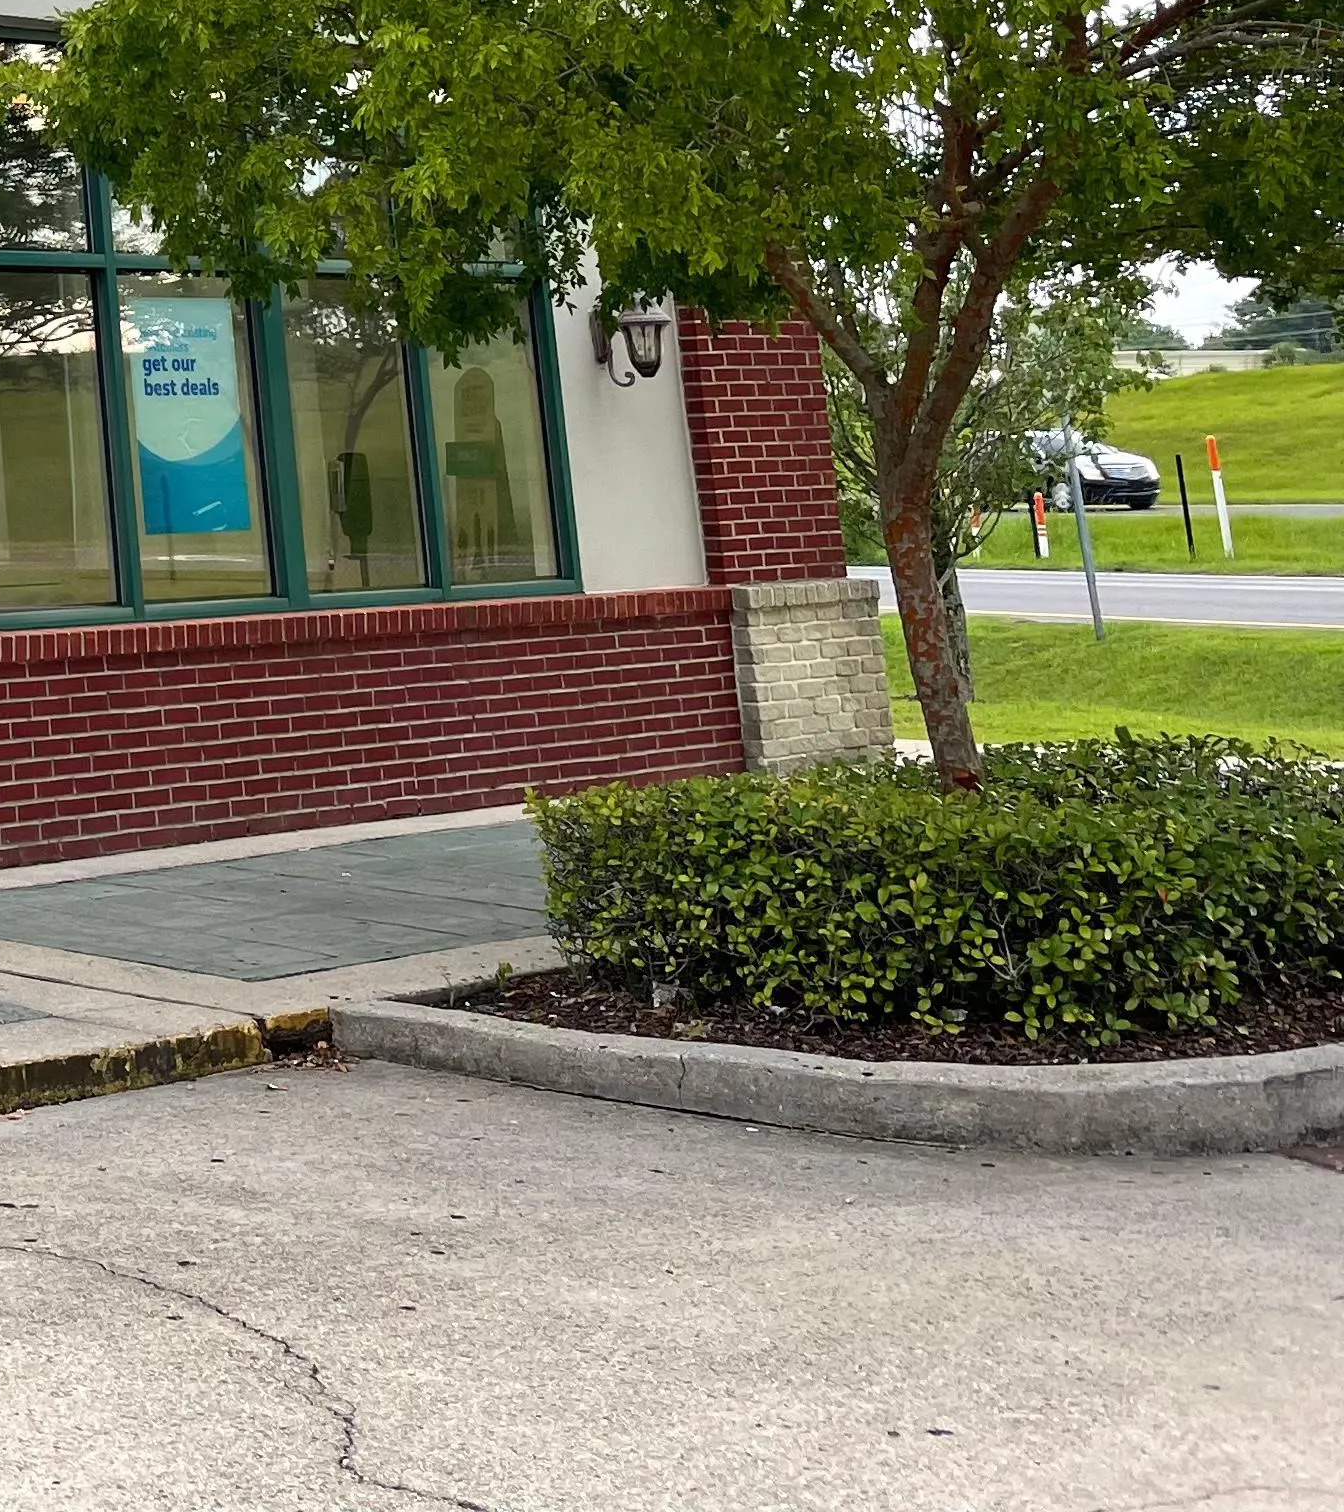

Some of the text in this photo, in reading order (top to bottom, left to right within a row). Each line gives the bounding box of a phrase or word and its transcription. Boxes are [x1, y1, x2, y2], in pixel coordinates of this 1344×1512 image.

[143, 356, 196, 376] get our
[144, 378, 219, 396] best deals
